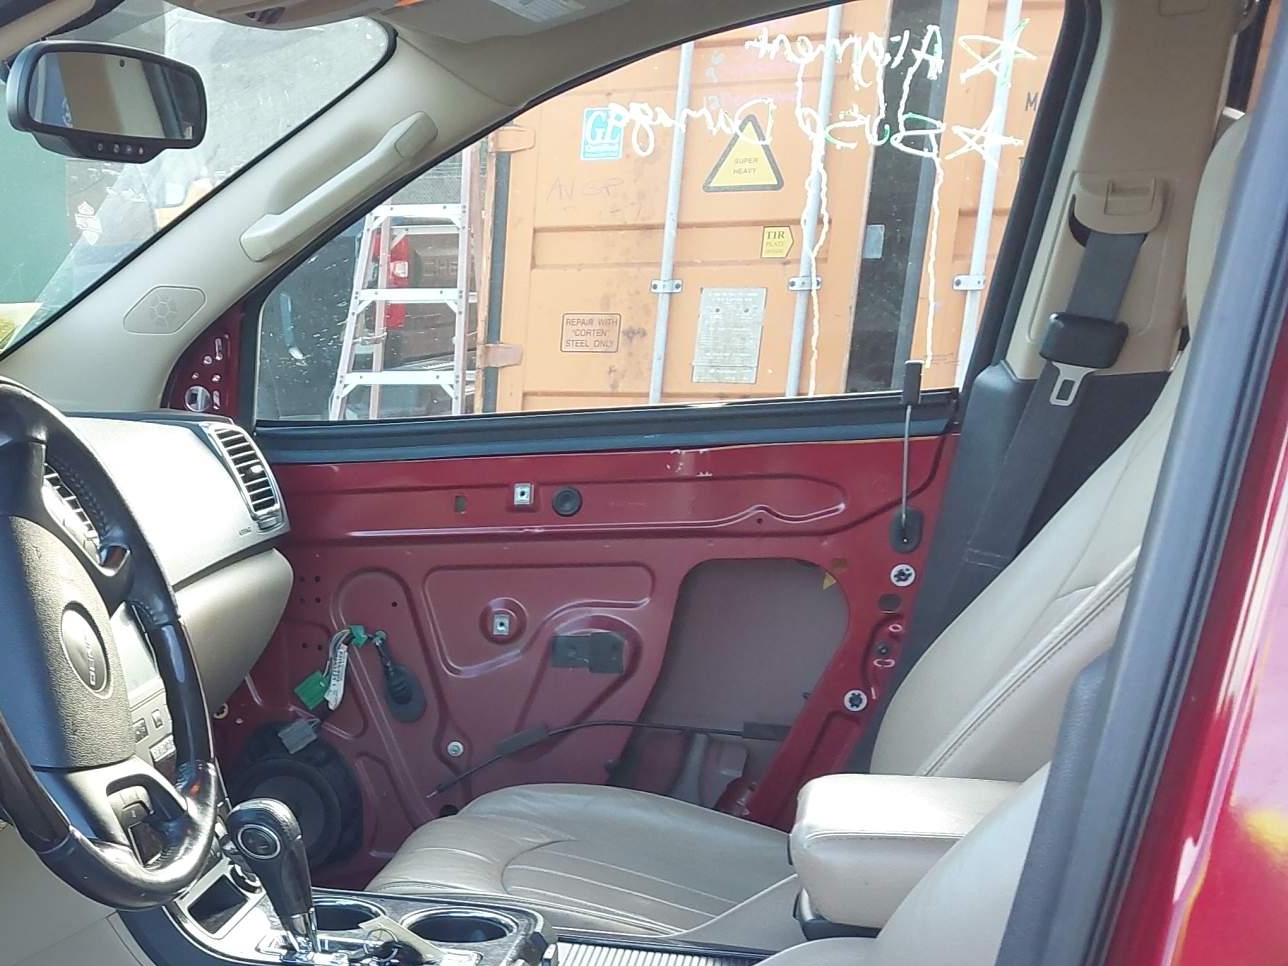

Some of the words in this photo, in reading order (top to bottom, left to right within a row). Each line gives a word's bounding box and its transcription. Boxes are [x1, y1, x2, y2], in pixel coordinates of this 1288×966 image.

[734, 157, 759, 166] SUPER
[766, 231, 785, 240] TIR
[565, 318, 594, 327] REPAIR
[598, 318, 618, 327] WITH
[565, 339, 590, 348] STEEL
[593, 339, 615, 348] ONLY
